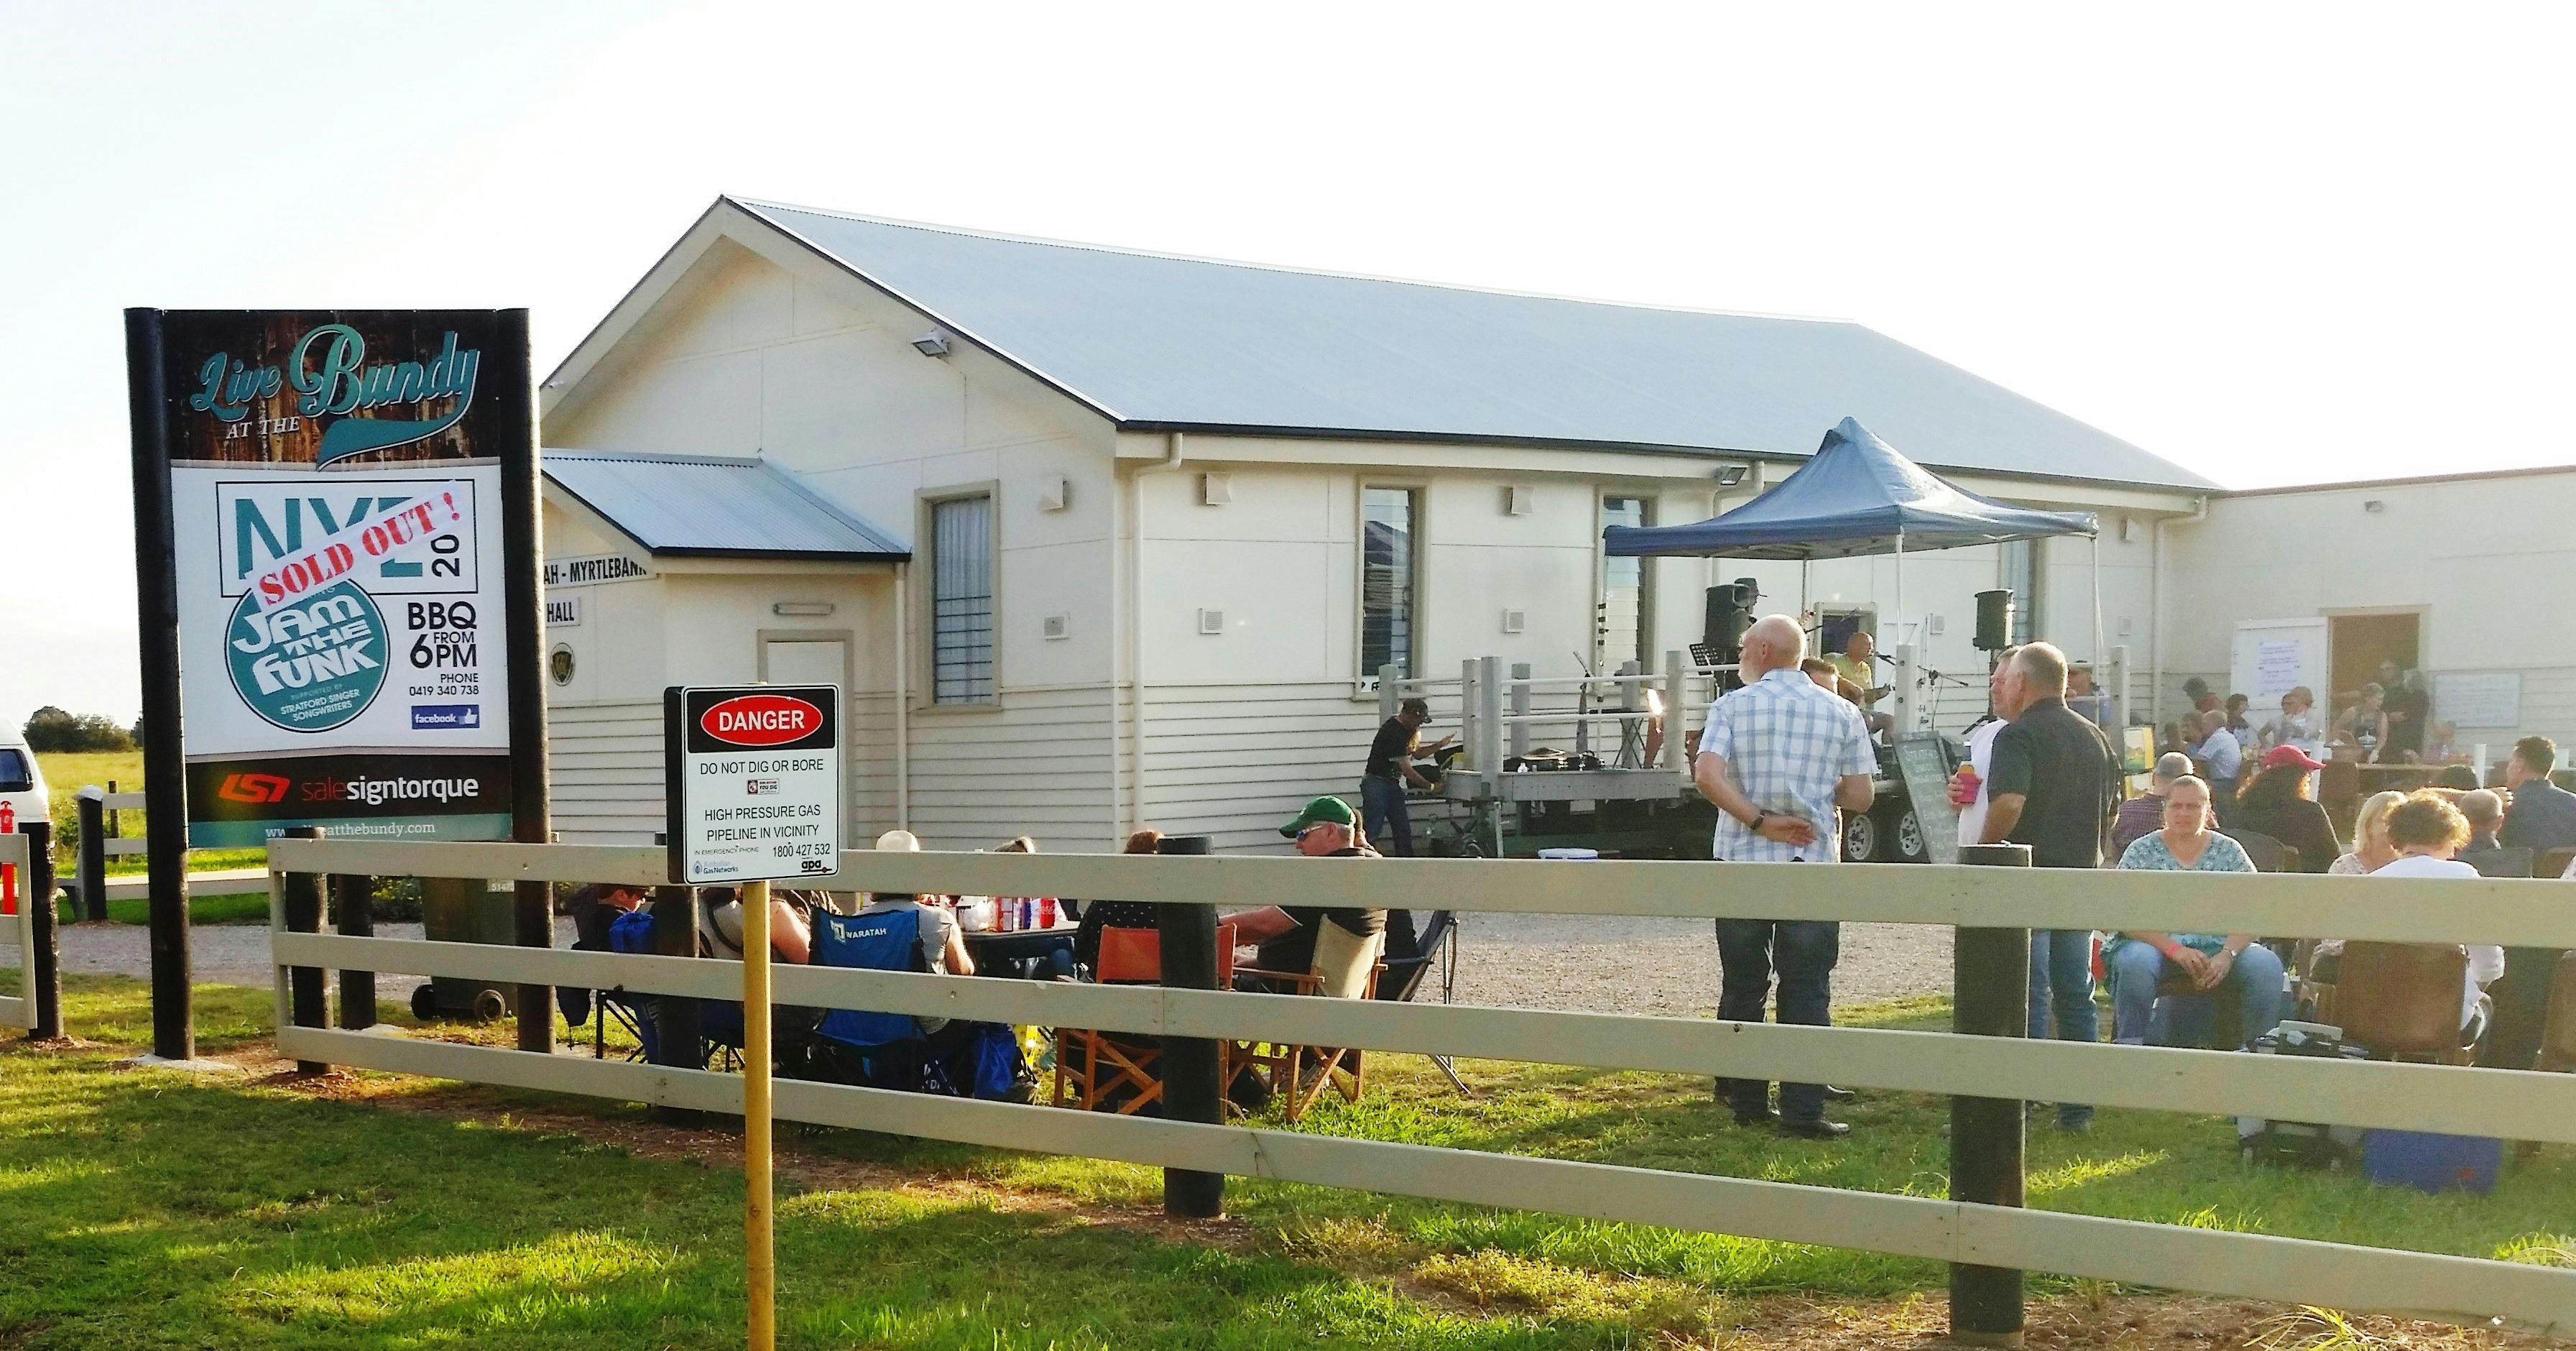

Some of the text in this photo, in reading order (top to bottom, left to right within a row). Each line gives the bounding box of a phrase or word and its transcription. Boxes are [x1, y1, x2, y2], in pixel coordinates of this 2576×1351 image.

[190, 323, 480, 451] Live Bundy
[226, 416, 300, 439] AT THE
[259, 543, 354, 606] SOLD
[361, 501, 436, 556] OUT
[407, 601, 477, 630] BBQ
[547, 601, 575, 623] HALL
[283, 619, 371, 657] THE
[433, 631, 474, 644] FROM
[252, 637, 380, 696] FUNK
[440, 673, 479, 683] PHONE
[409, 685, 479, 696] 0419 340 738
[280, 688, 361, 715] STRATFORD SINGER
[292, 700, 353, 721] SONGWRITERS
[414, 713, 457, 724] facebook
[719, 710, 805, 732] DANGER
[700, 759, 824, 775] DO NOT DIG OR BORE
[704, 804, 821, 821] HIGH PRESSURE GAS
[707, 824, 820, 842] PIPELINE IN VICINITY
[772, 843, 831, 857] 1800 427 532
[801, 859, 821, 872] apa
[845, 928, 887, 939] WARATAH
